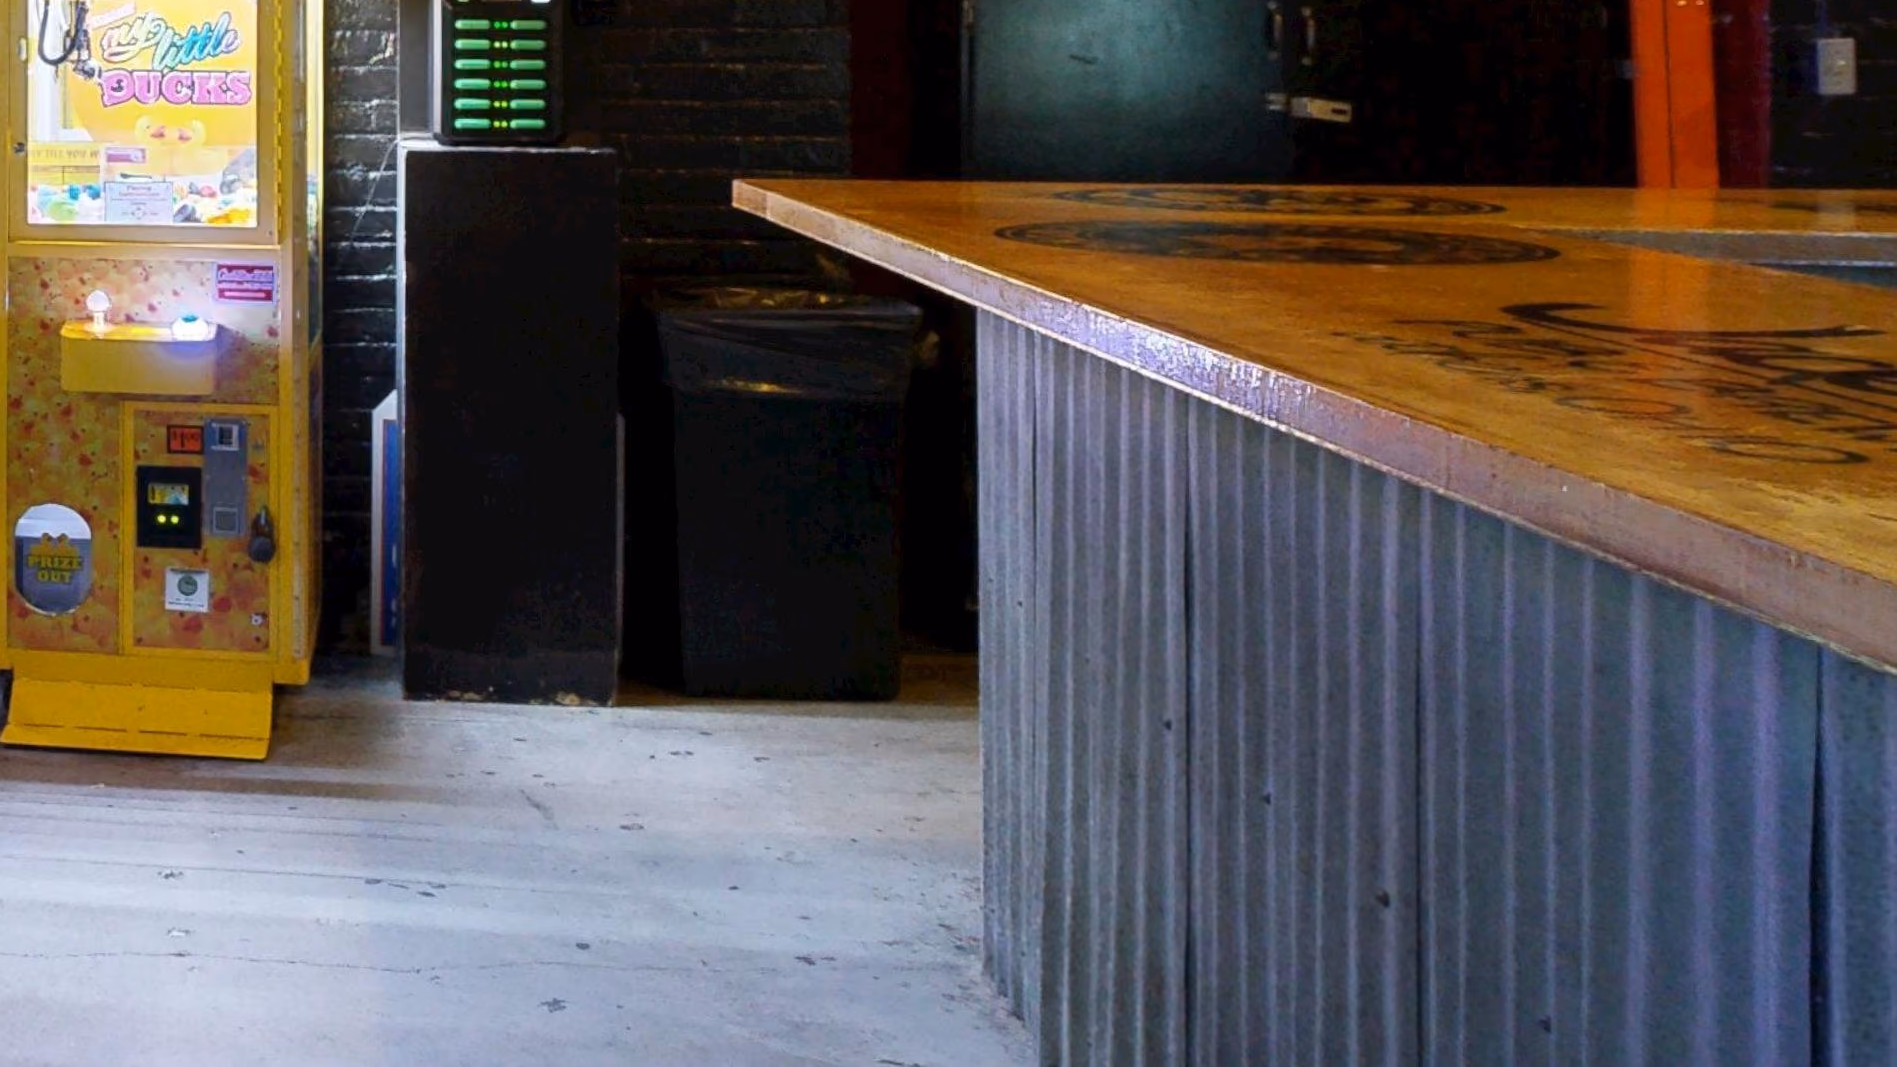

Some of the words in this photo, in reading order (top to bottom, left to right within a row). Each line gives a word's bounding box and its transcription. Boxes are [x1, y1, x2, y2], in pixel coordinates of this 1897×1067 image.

[151, 10, 242, 72] little
[99, 68, 253, 108] DUCKS
[27, 555, 83, 570] PRIZE
[36, 569, 73, 583] OUT
